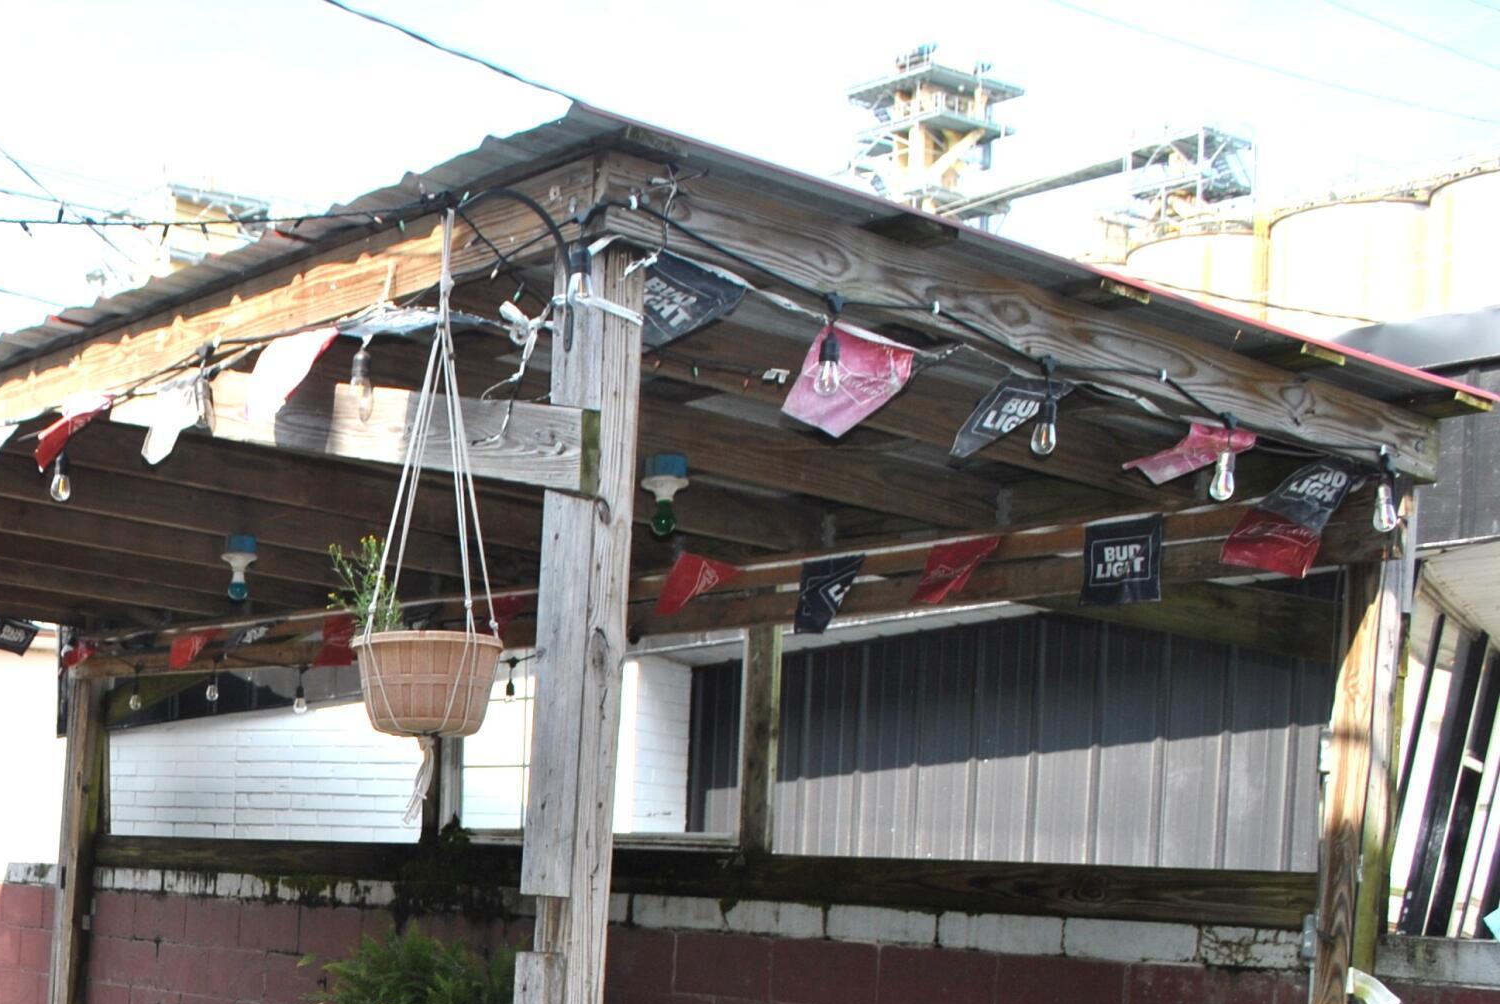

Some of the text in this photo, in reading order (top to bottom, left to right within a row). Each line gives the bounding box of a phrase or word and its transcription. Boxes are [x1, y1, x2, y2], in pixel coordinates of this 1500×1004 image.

[982, 410, 1026, 433] LIG
[1289, 481, 1335, 502] LIGH
[1104, 543, 1142, 562] BUD
